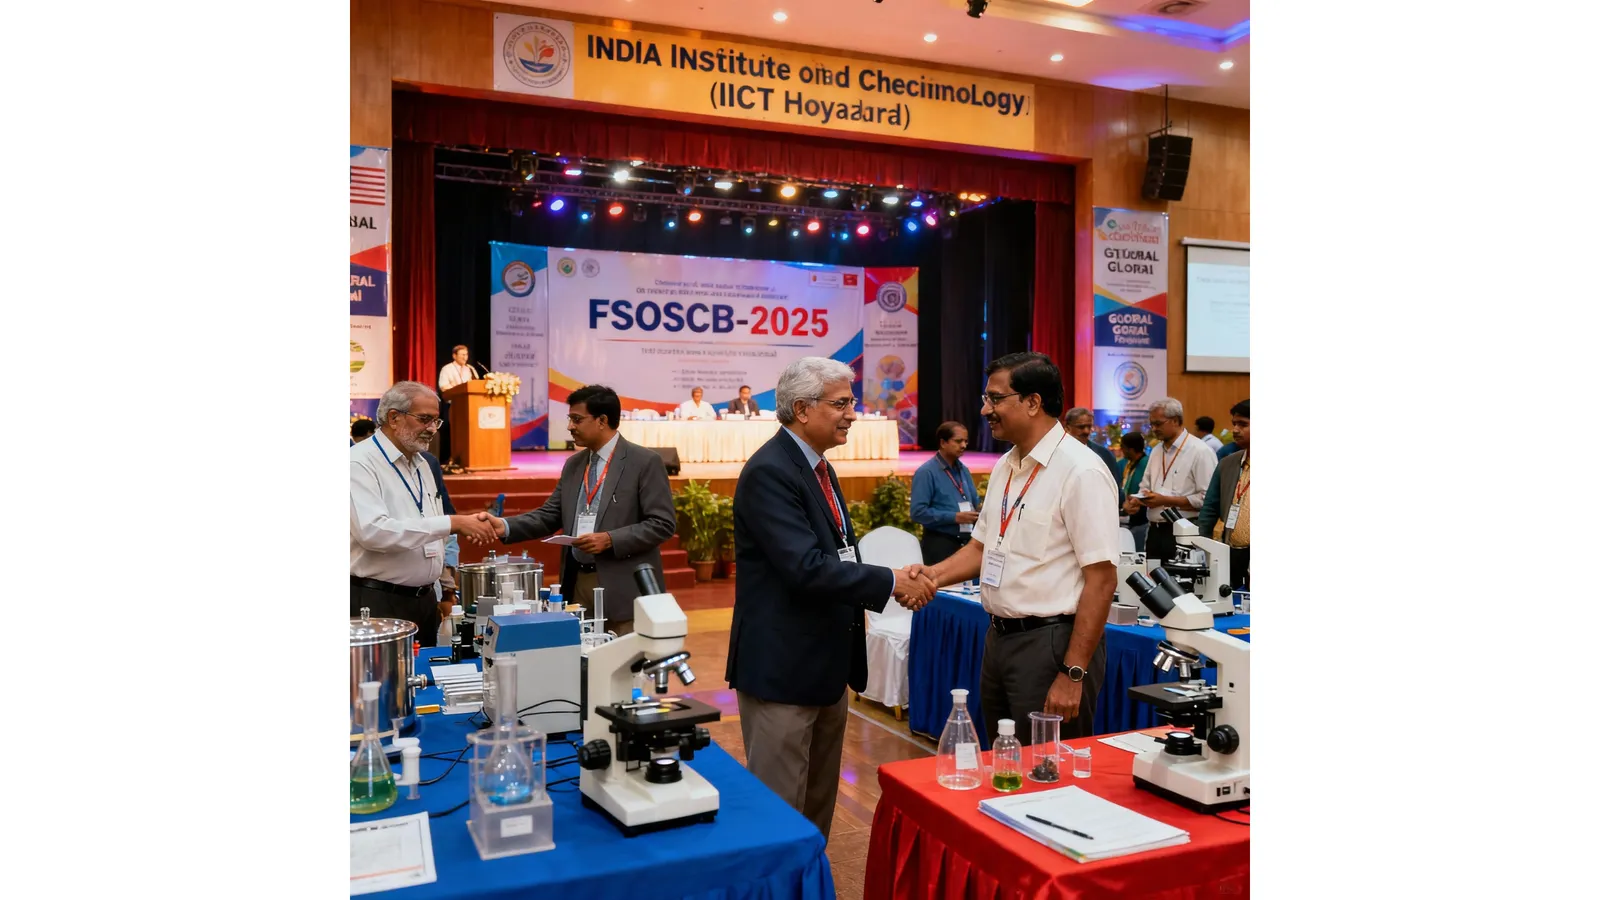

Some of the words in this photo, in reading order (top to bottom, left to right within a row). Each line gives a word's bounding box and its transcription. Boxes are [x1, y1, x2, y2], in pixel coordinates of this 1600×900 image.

[588, 35, 662, 66] INDIA
[710, 81, 774, 111] (IICT
[588, 299, 829, 338] FSOSCB-2025
